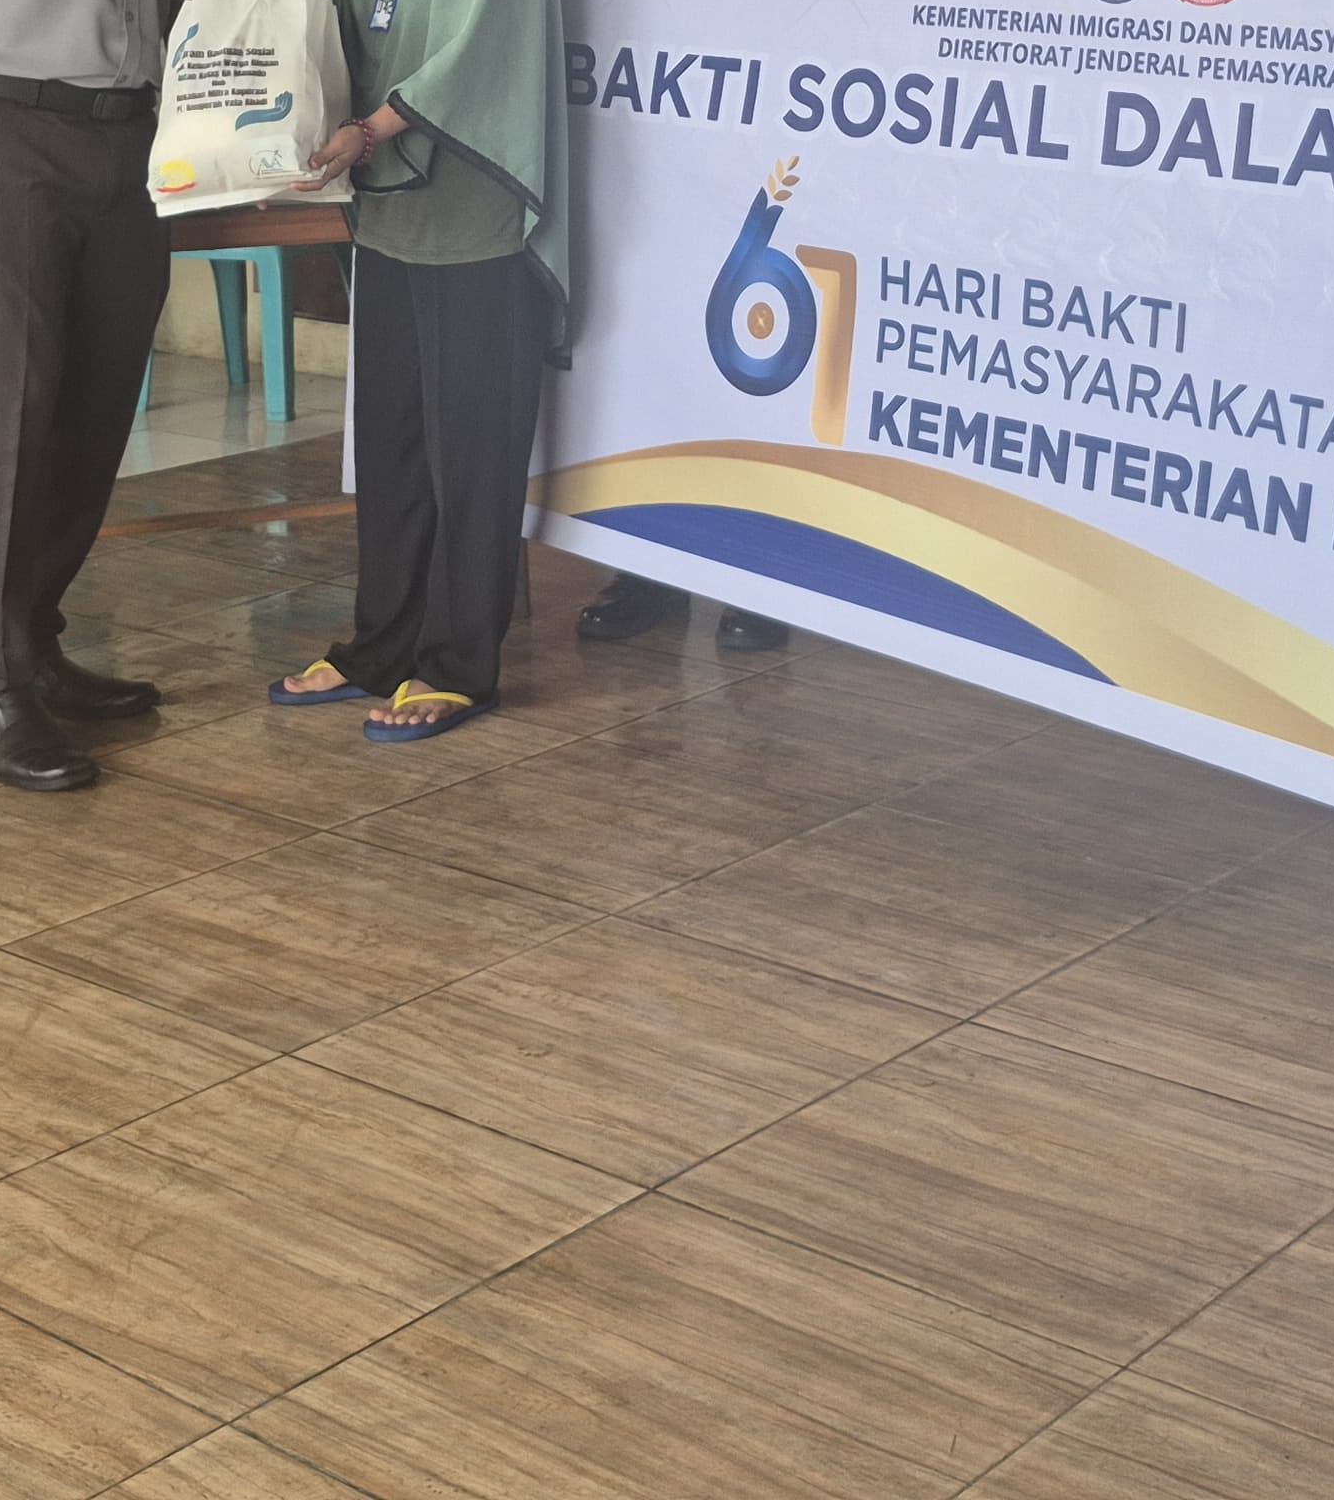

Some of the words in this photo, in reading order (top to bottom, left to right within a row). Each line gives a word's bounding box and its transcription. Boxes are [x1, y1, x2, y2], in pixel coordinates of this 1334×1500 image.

[912, 4, 1063, 36] KEMENTERIAN
[1069, 14, 1172, 43] IMIGRASI
[1180, 21, 1233, 47] DAN
[938, 37, 1072, 68] DIREKTORAT
[1074, 46, 1190, 78] JENDERAL
[564, 41, 763, 125] BAKTI
[782, 62, 1069, 161] SOSIAL
[879, 256, 1002, 321] HARI
[1021, 278, 1187, 354] BAKTI
[868, 391, 1314, 543] KEMENTERIAN
